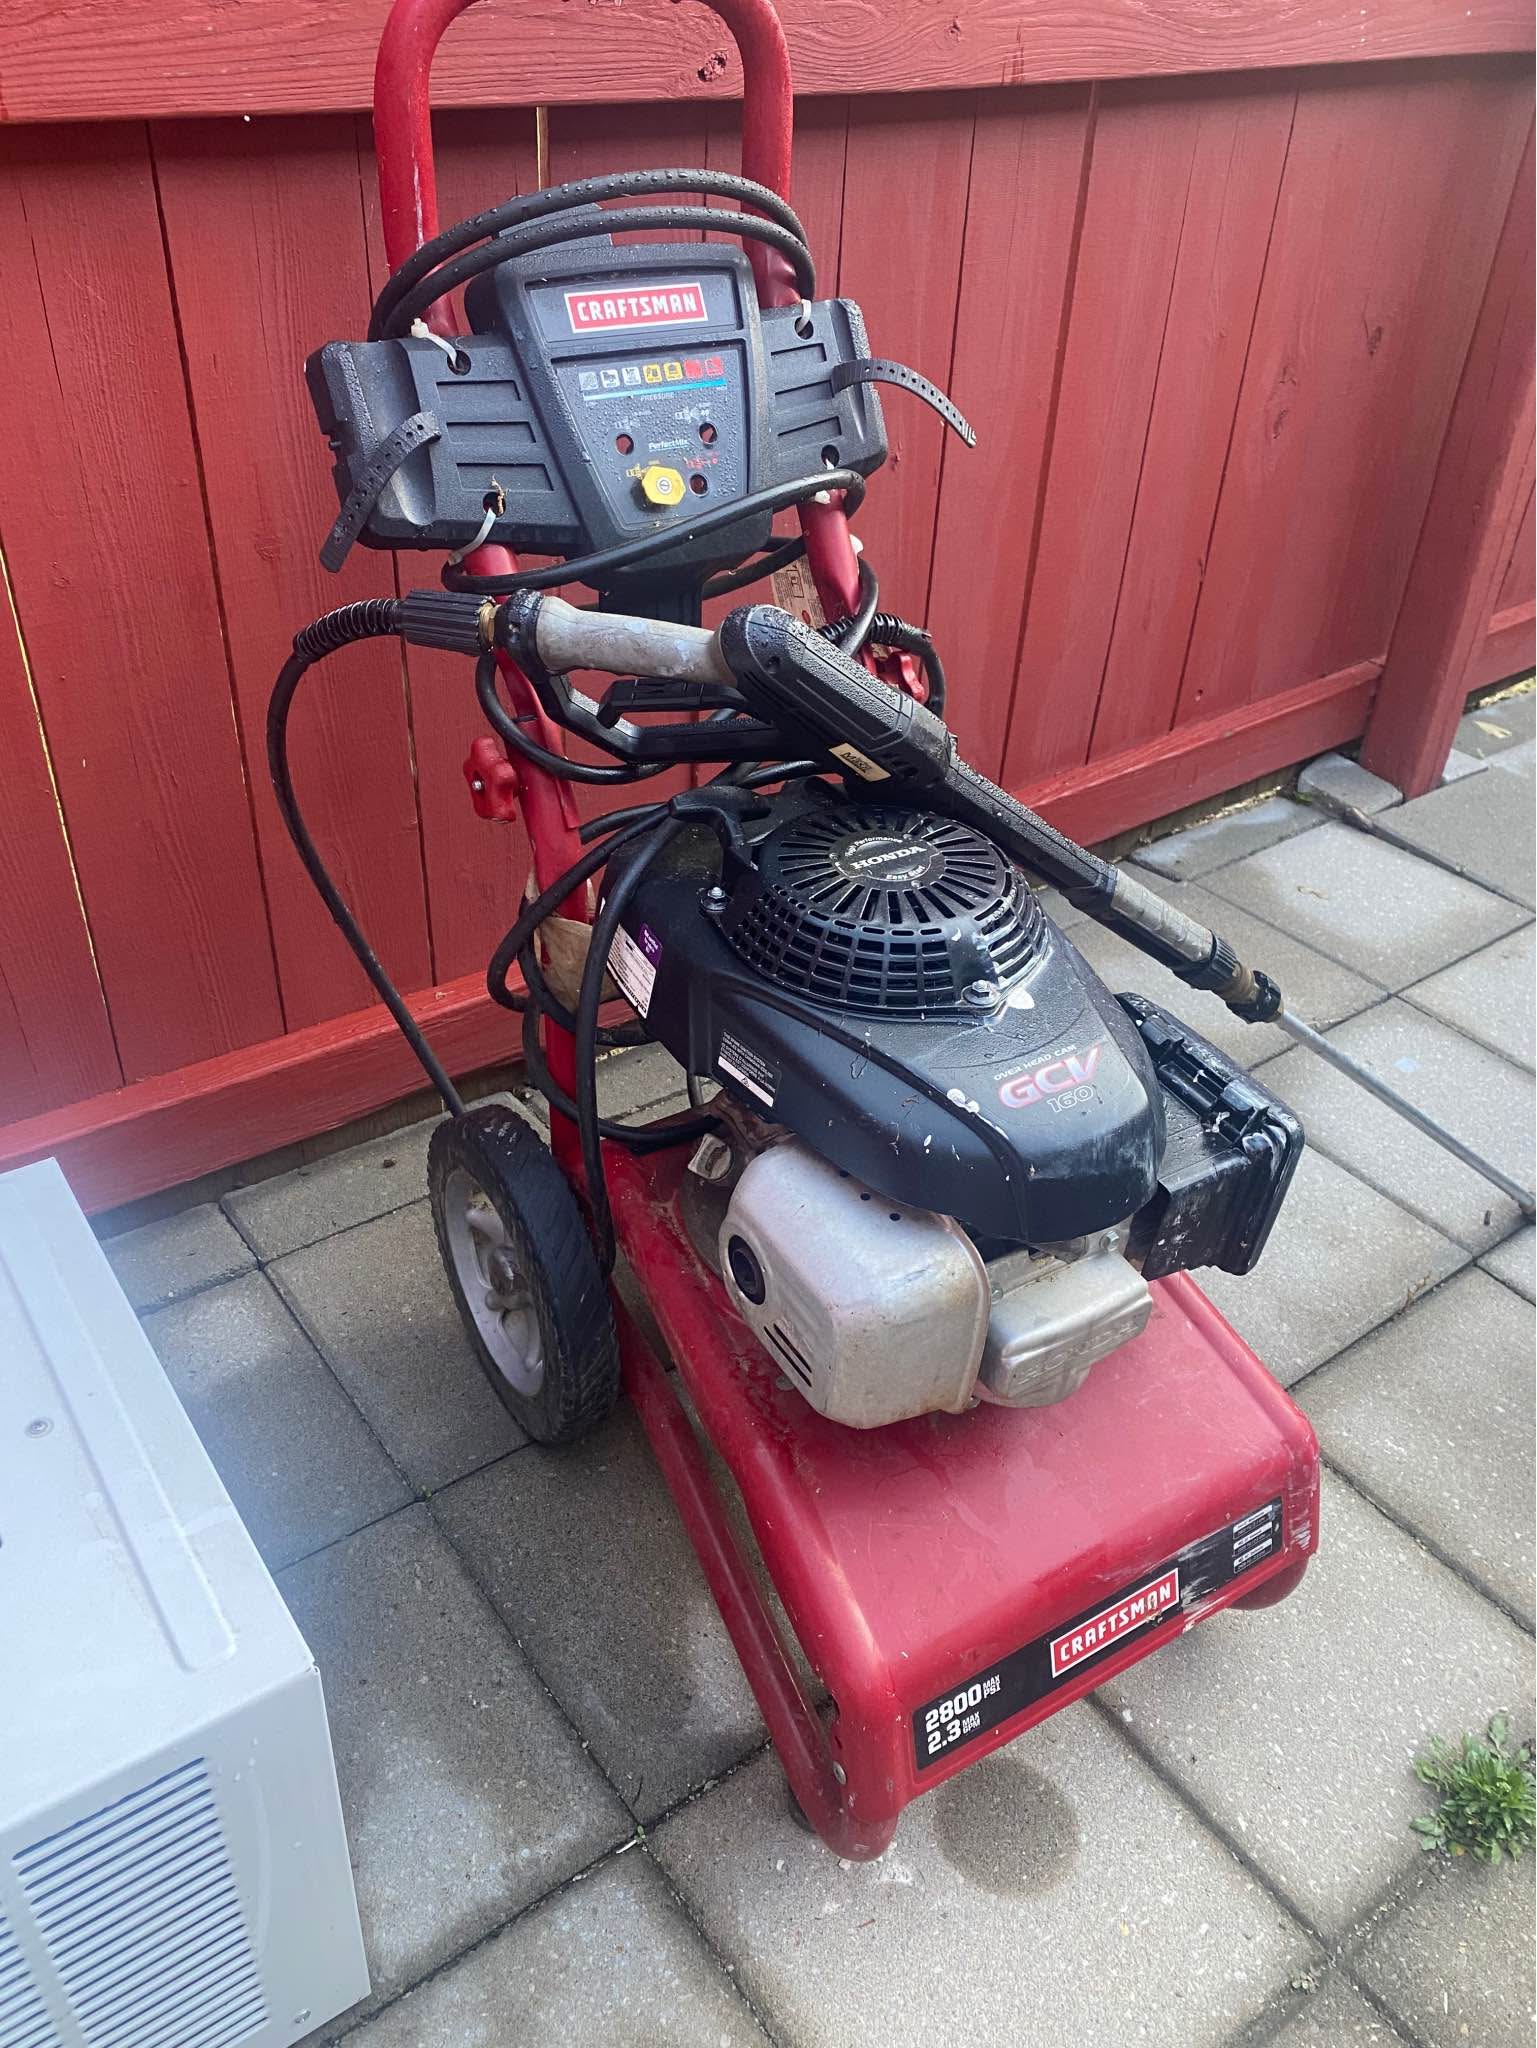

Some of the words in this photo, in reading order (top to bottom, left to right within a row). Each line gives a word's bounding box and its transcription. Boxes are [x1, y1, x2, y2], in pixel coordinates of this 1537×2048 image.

[576, 293, 698, 322] CRAFTSMAN
[850, 846, 928, 870] HONDA
[994, 1065, 1023, 1081] OVER
[1023, 1054, 1052, 1069] HEAD
[1054, 1044, 1077, 1057] CAM
[999, 1044, 1102, 1109] GCV
[1046, 1085, 1094, 1113] 160
[1060, 1582, 1171, 1662] CRAFTSMAN
[925, 1683, 982, 1733] 2800
[982, 1674, 1001, 1690] MAX
[983, 1682, 1001, 1699] PSI
[927, 1718, 961, 1755] 2.3
[962, 1711, 980, 1727] MAX
